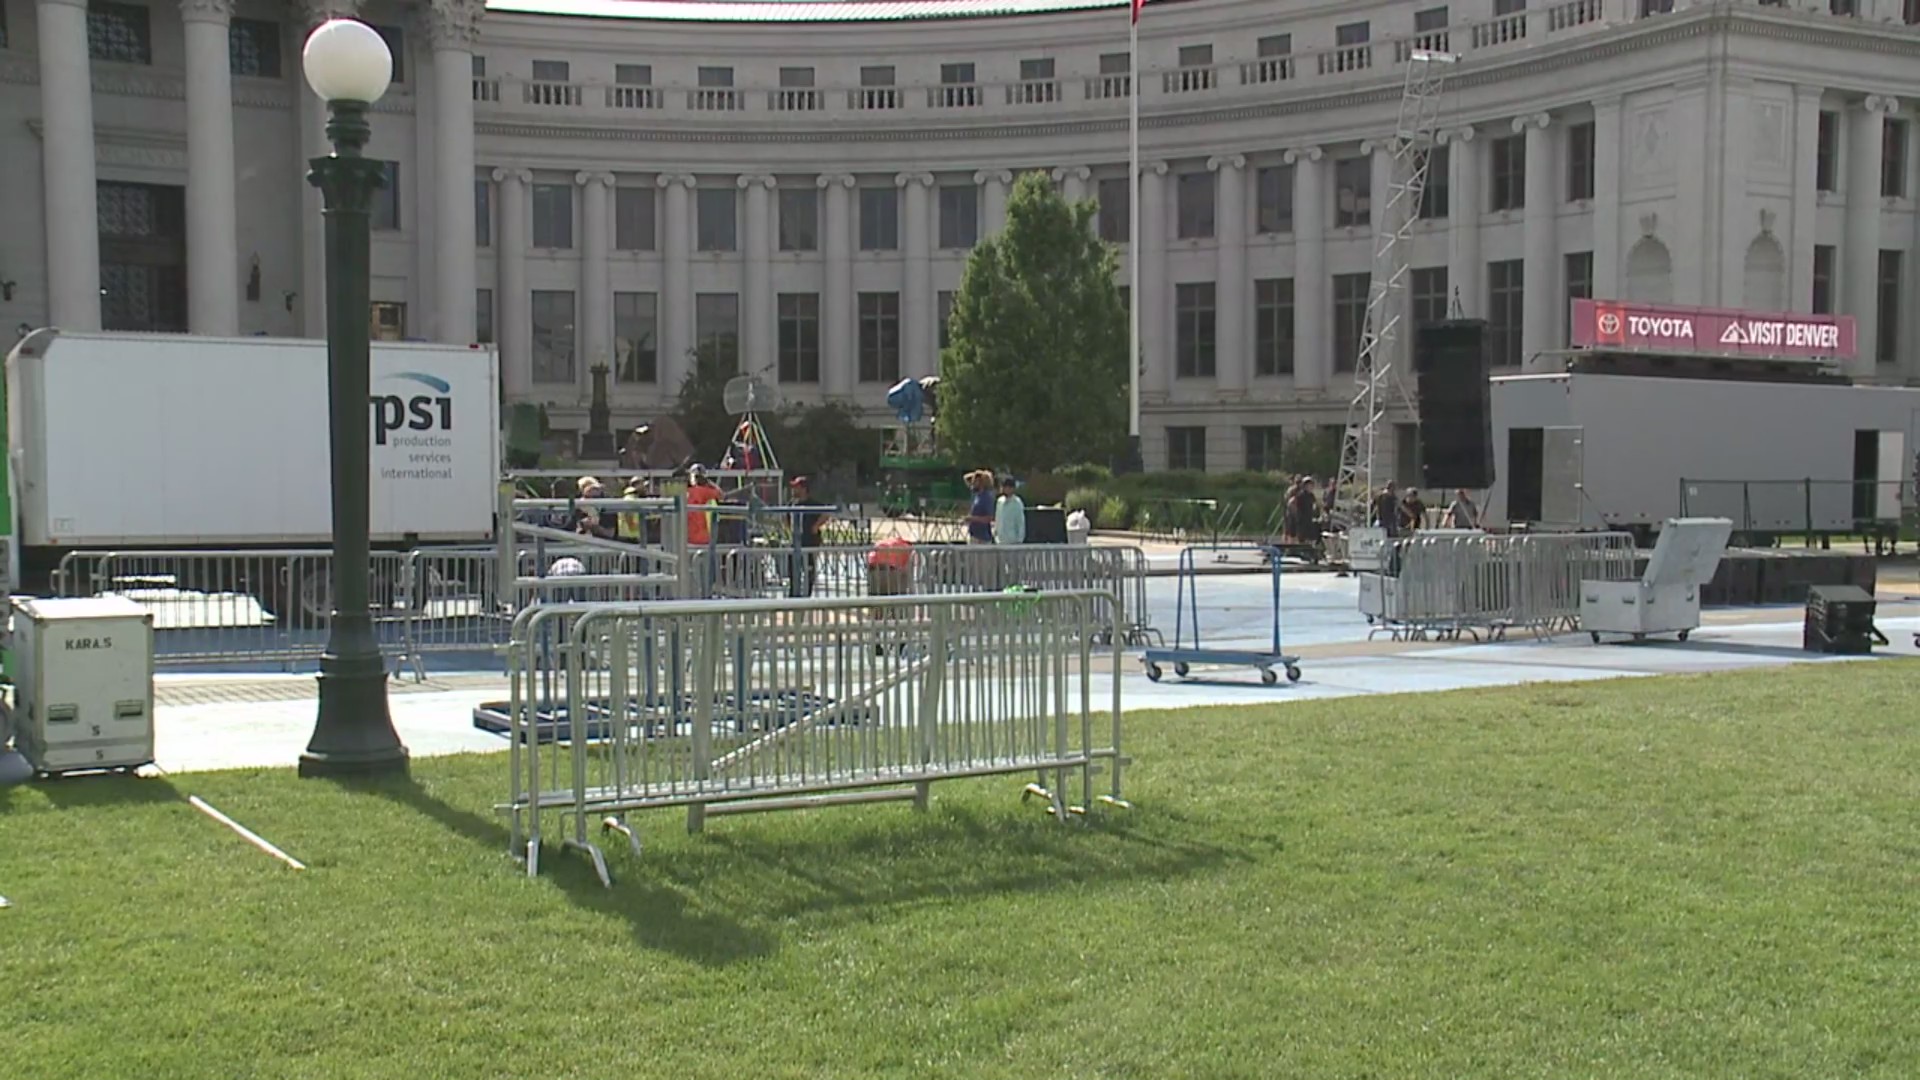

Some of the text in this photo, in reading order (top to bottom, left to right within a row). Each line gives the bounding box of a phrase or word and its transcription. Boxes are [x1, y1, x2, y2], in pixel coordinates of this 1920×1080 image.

[1628, 315, 1694, 339] TOYOTA
[1748, 320, 1838, 348] VISIT DENVER
[369, 395, 451, 445] psi
[393, 435, 451, 448] production
[408, 452, 451, 463] services
[381, 468, 452, 479] international
